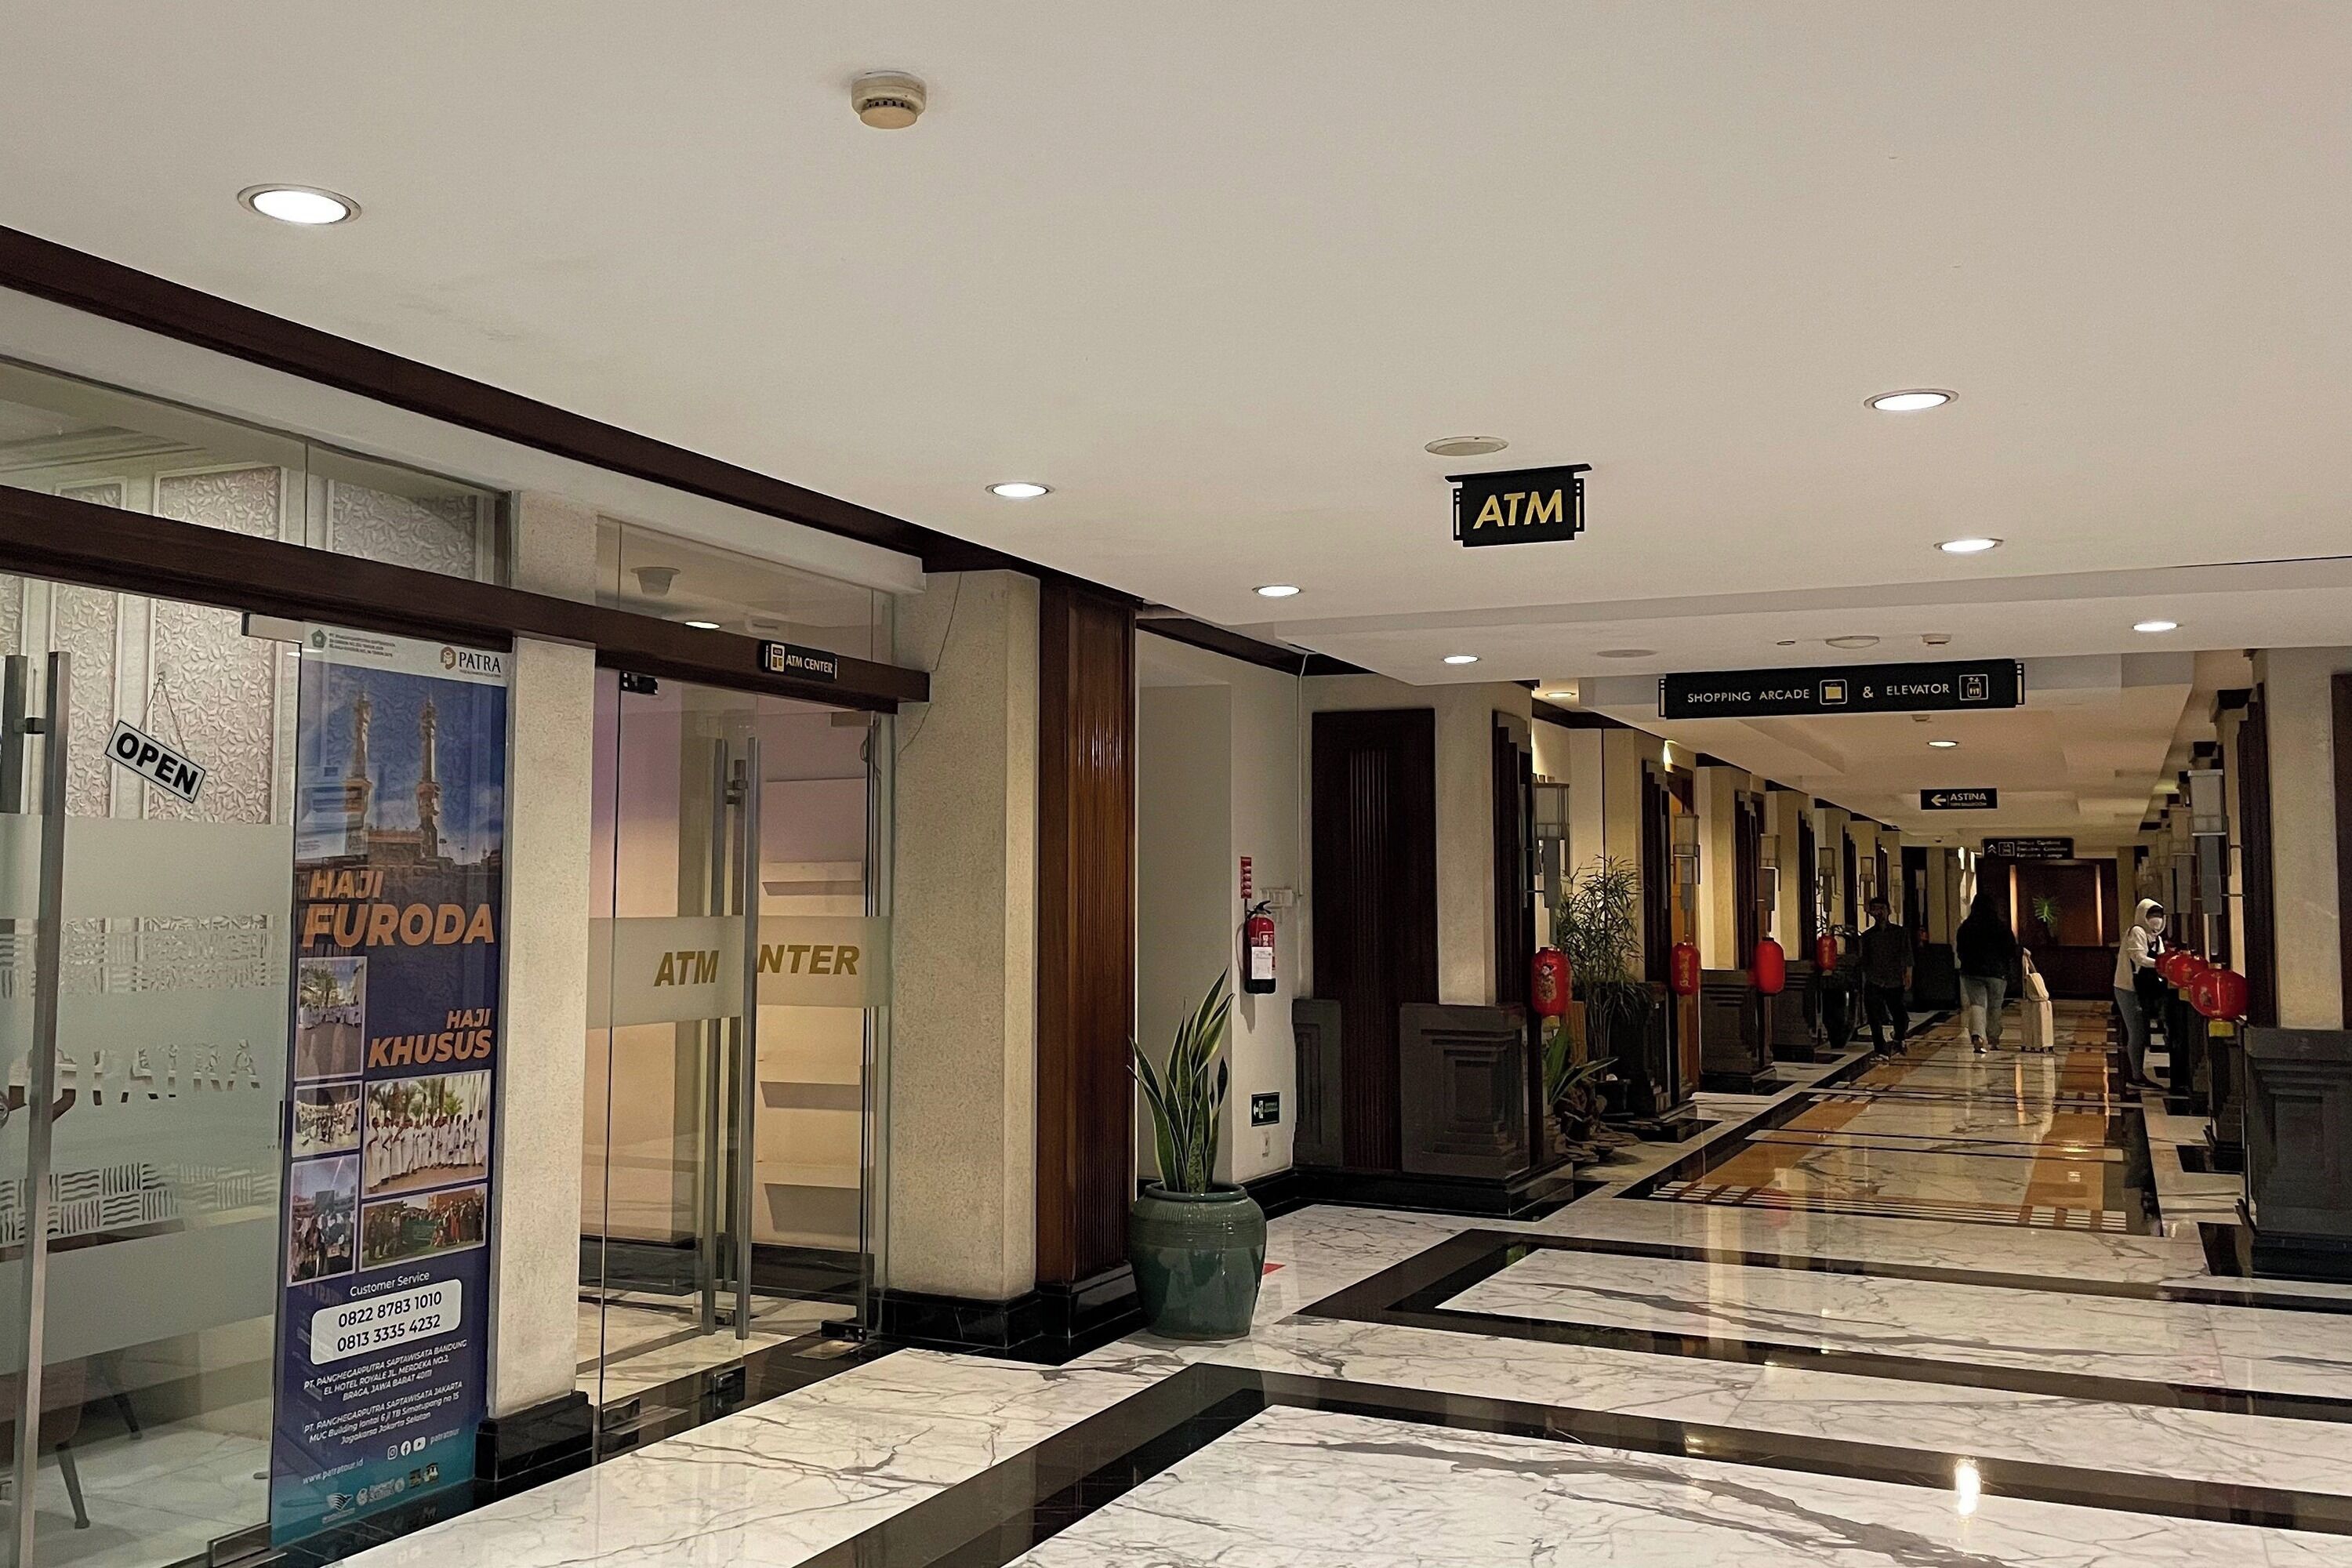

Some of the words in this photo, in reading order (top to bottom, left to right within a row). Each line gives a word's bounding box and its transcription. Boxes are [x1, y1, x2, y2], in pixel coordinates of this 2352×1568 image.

[1472, 489, 1563, 529] ATM
[459, 652, 501, 673] PATRA
[786, 655, 802, 667] ATM
[804, 658, 833, 673] CENTER
[1687, 691, 1751, 703] SHOPPING
[1759, 688, 1810, 700] ARCADE
[1862, 686, 1875, 699] &
[1886, 684, 1950, 695] ELEVATOR
[117, 732, 198, 795] OPEN
[308, 869, 383, 898] HAJI
[301, 903, 494, 948] FURODA
[653, 950, 719, 987] ATM
[757, 944, 860, 975] NTER
[446, 1008, 492, 1029] HAJI
[367, 1029, 492, 1069] KHUSUS
[350, 1279, 395, 1297] Customer
[397, 1272, 430, 1286] Service
[339, 1308, 373, 1327] 0822
[377, 1298, 410, 1319] 8783
[415, 1291, 442, 1310] 1010
[337, 1331, 369, 1352] 0813
[373, 1322, 405, 1343] 3335
[408, 1314, 441, 1332] 4232
[434, 1339, 467, 1355] BANDUNG
[324, 1386, 333, 1396] EL
[334, 1377, 358, 1392] HOTEL
[359, 1371, 387, 1385] ROYALE
[370, 1381, 391, 1393] JAWA
[392, 1374, 416, 1388] BARAT
[434, 1381, 463, 1396] JAKARTA
[309, 1433, 327, 1443] MUC
